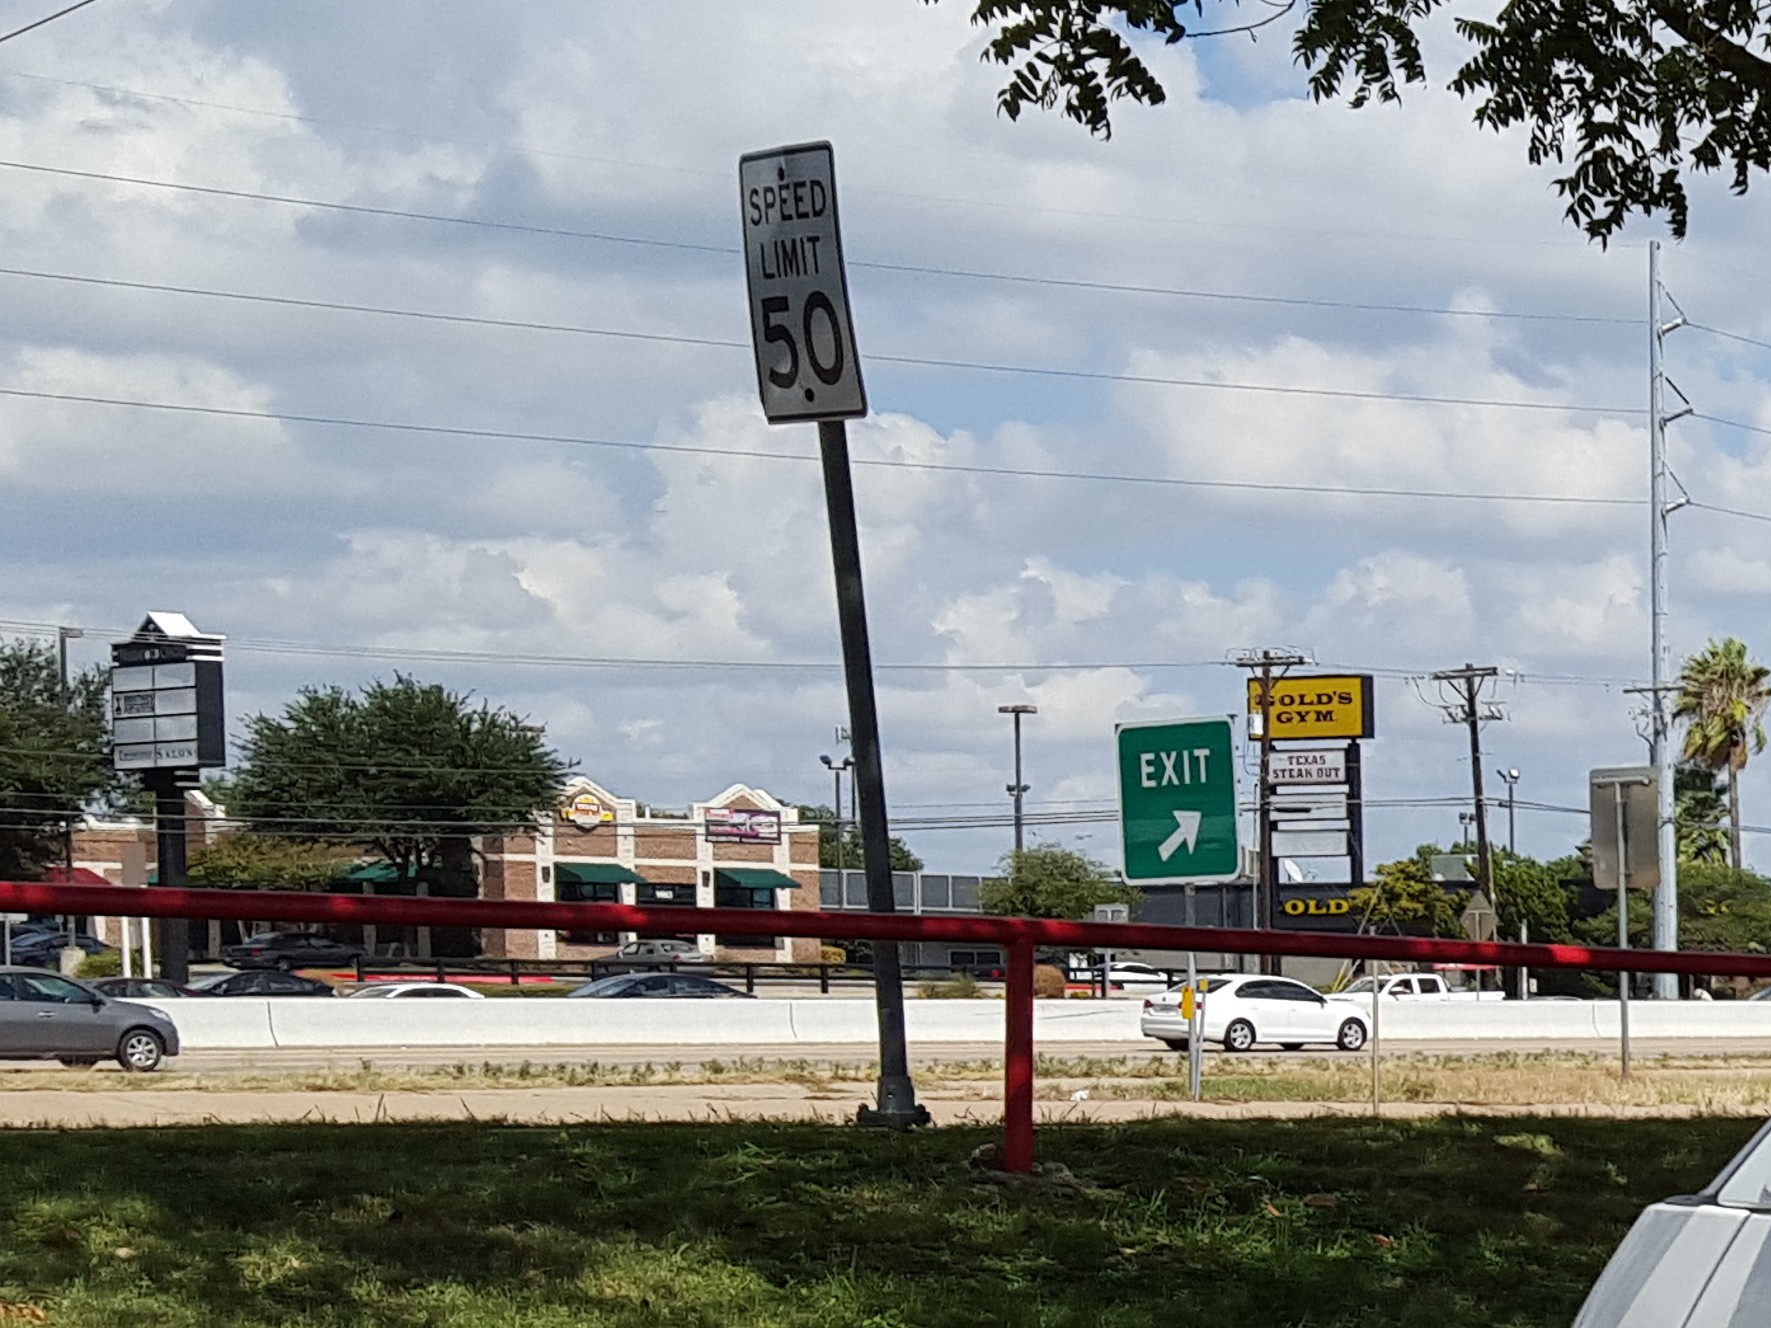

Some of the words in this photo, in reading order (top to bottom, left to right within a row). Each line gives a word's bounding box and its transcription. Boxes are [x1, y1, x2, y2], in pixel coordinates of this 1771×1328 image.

[750, 179, 827, 226] SPEED
[760, 236, 820, 280] LIMIT
[761, 291, 844, 389] 50
[1276, 709, 1335, 724] GYM
[1140, 748, 1211, 788] EXIT
[1287, 755, 1326, 766] TEXAS
[1317, 767, 1341, 778] OUT
[1284, 899, 1350, 916] OLD
